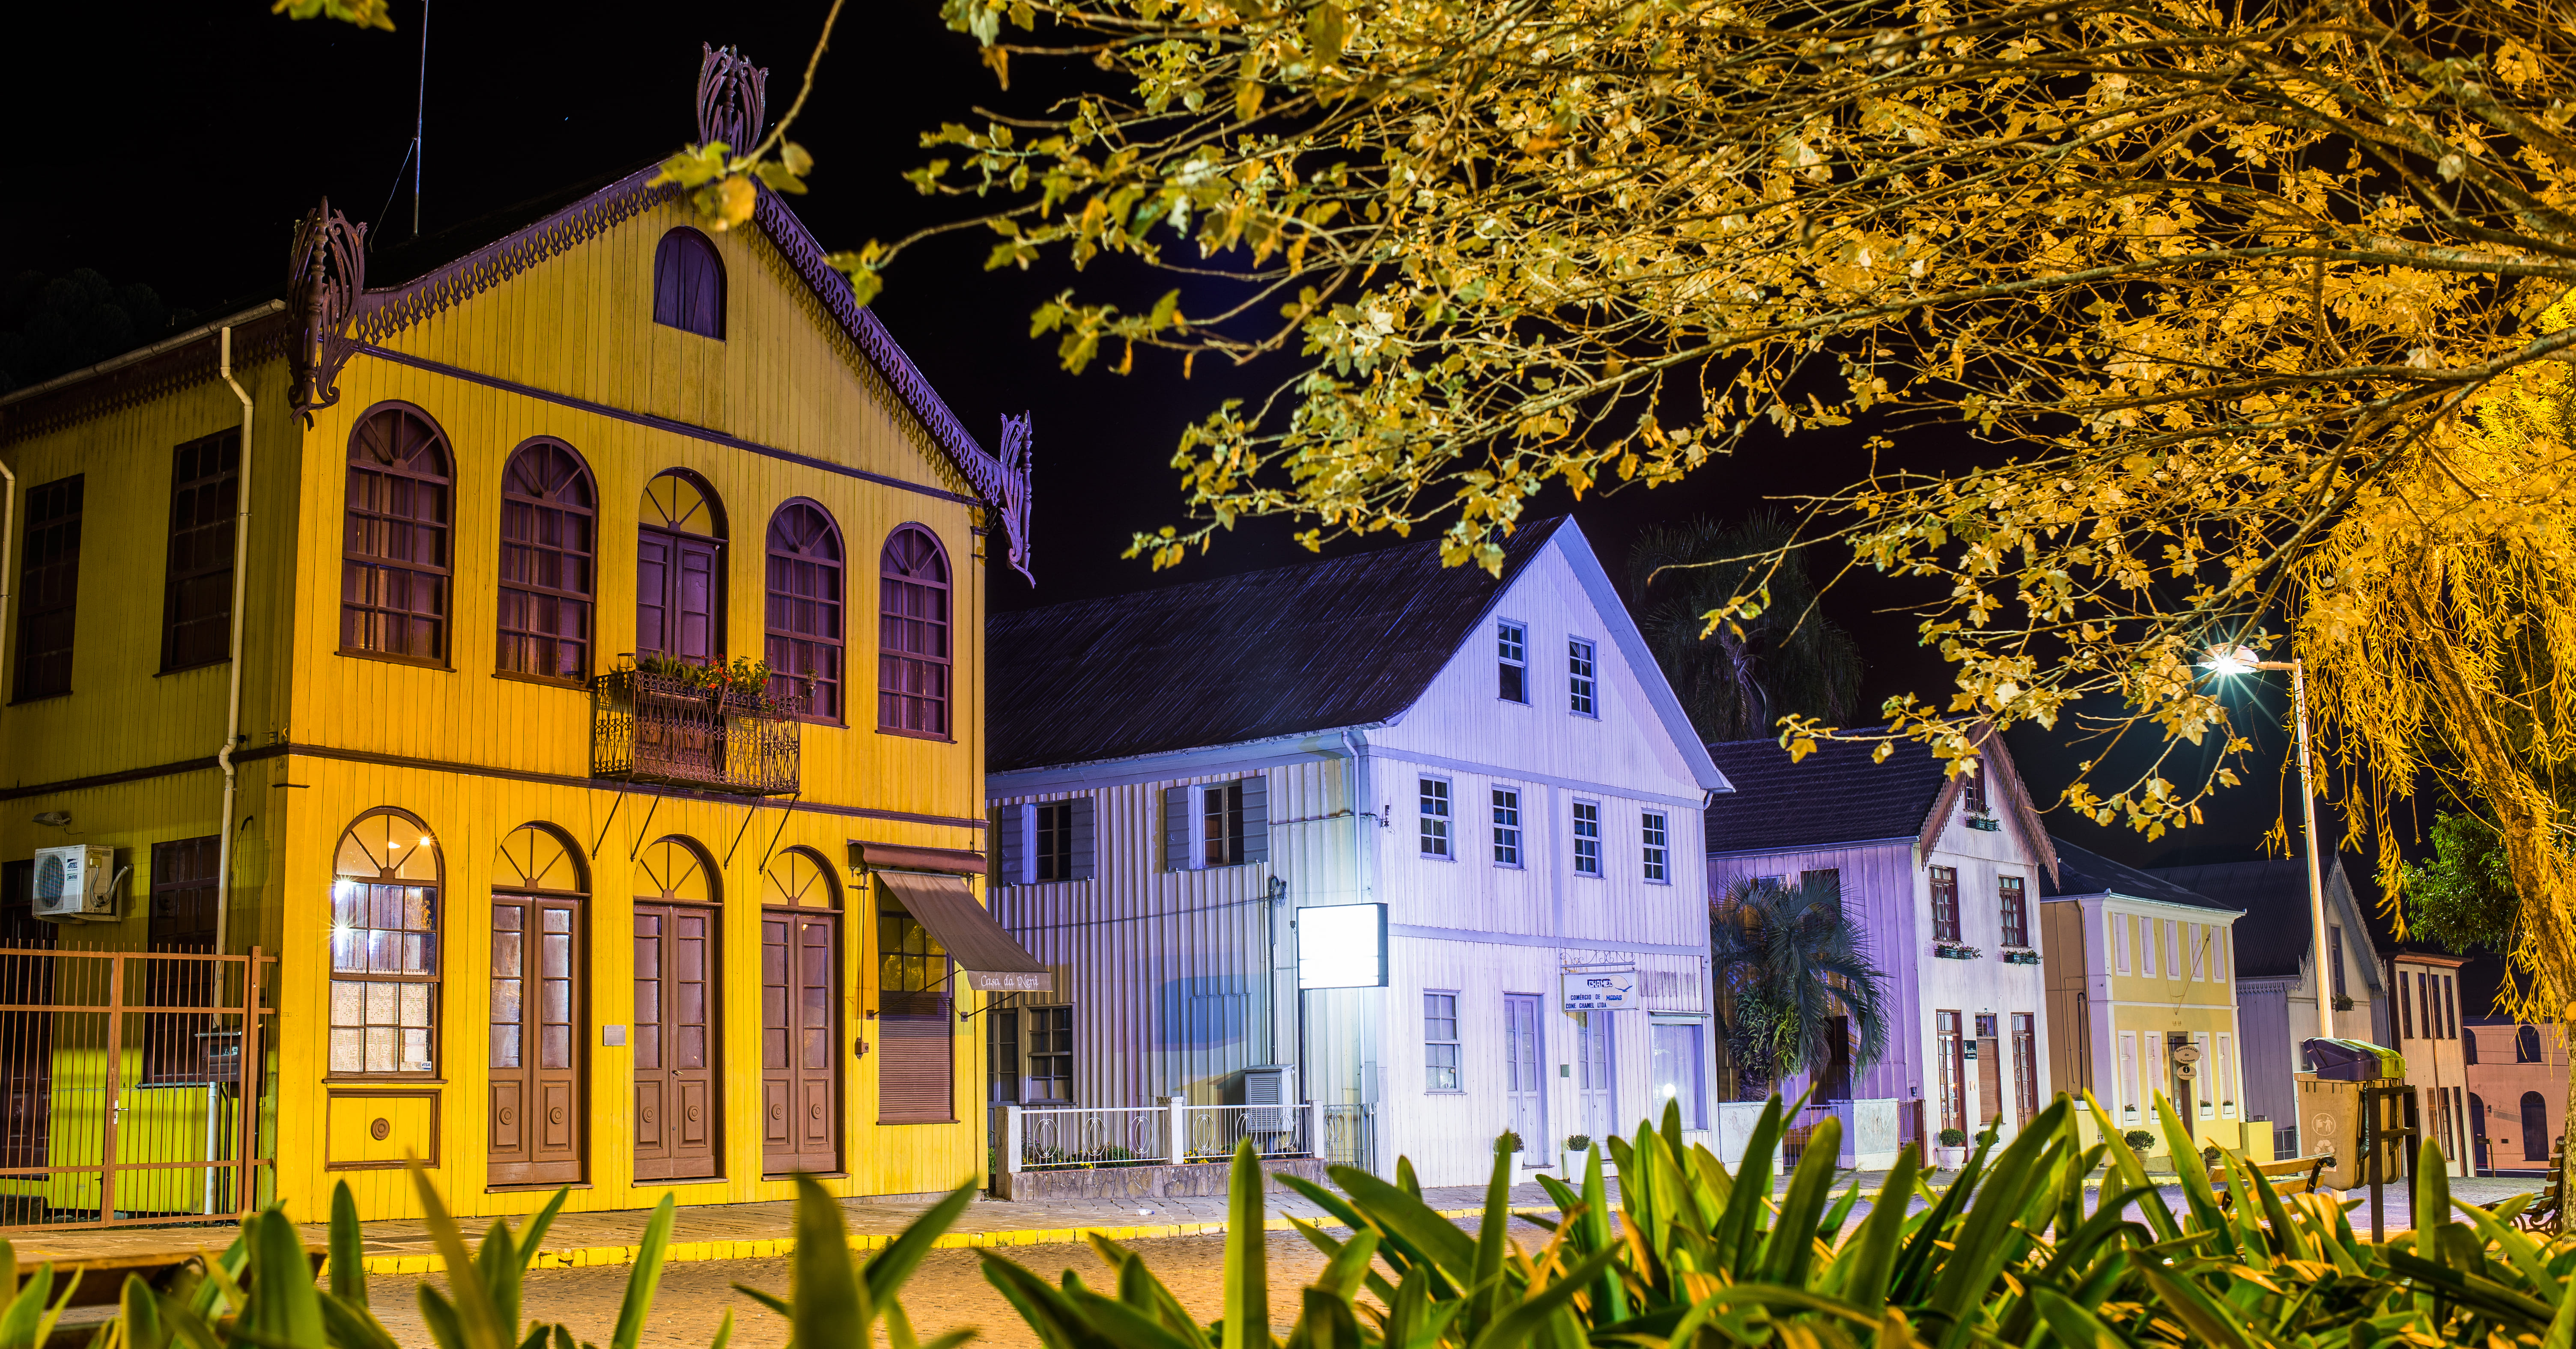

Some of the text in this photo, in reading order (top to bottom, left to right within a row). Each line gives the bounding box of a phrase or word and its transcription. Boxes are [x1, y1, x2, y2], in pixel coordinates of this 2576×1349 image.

[981, 974, 1039, 988] Casa da Neni
[1587, 979, 1613, 988] CHAMEL
